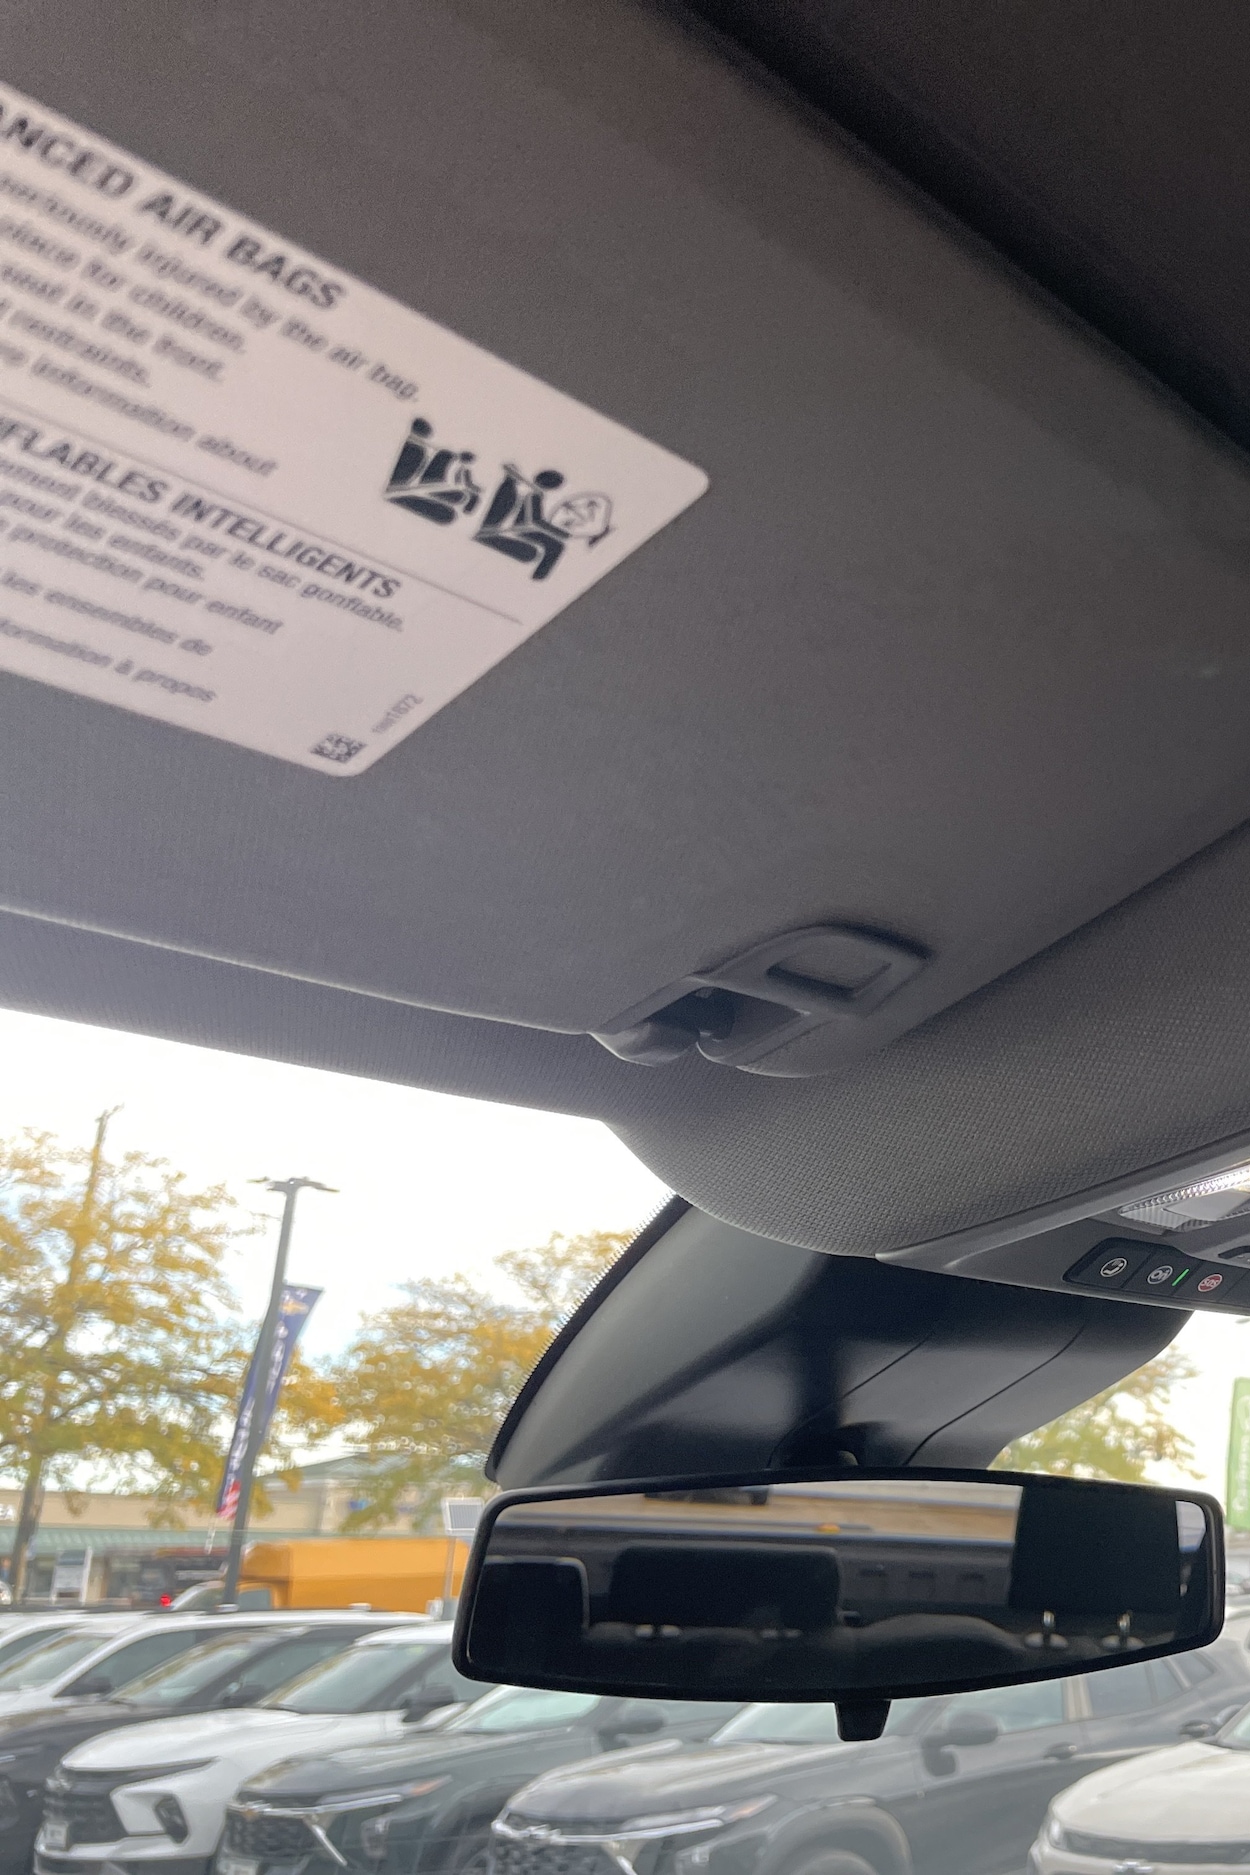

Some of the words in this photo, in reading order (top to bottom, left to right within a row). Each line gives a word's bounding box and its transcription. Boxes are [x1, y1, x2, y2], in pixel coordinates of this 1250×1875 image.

[0, 103, 136, 199] NCED
[141, 193, 223, 247] AIR
[226, 232, 346, 310] BAGS
[281, 315, 329, 351] the
[328, 346, 368, 371] air
[196, 433, 278, 478] about
[170, 492, 401, 599] INTELLIGENTS
[179, 533, 227, 560] par
[228, 550, 256, 571] le
[257, 563, 301, 589] sac
[143, 577, 204, 605] pour
[205, 600, 284, 635] enfant
[178, 637, 214, 657] de
[132, 669, 217, 703] propos
